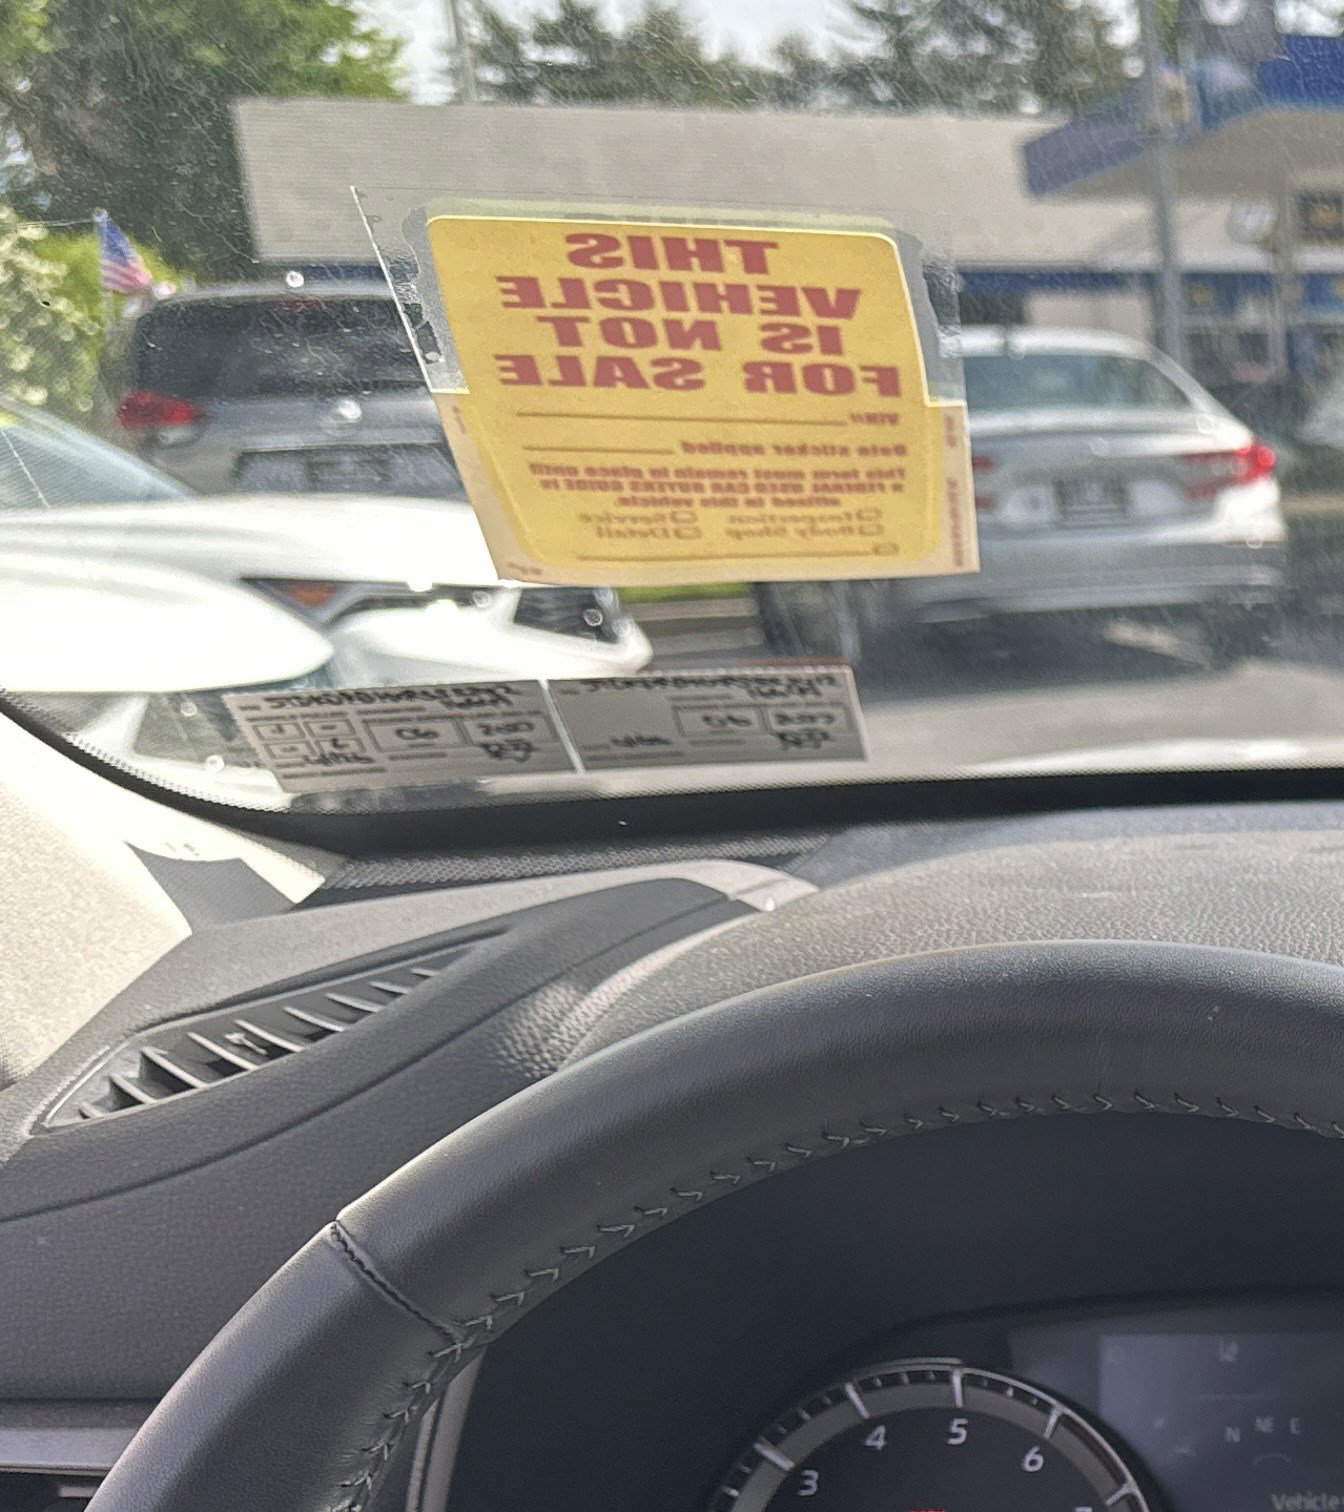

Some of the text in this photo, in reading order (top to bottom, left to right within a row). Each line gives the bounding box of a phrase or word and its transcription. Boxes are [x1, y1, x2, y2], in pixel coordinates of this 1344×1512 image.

[864, 1425, 886, 1451] 4
[948, 1420, 969, 1445] 5
[1023, 1447, 1044, 1473] 6
[798, 1470, 819, 1497] 3
[1272, 1490, 1342, 1511] Vehicle
